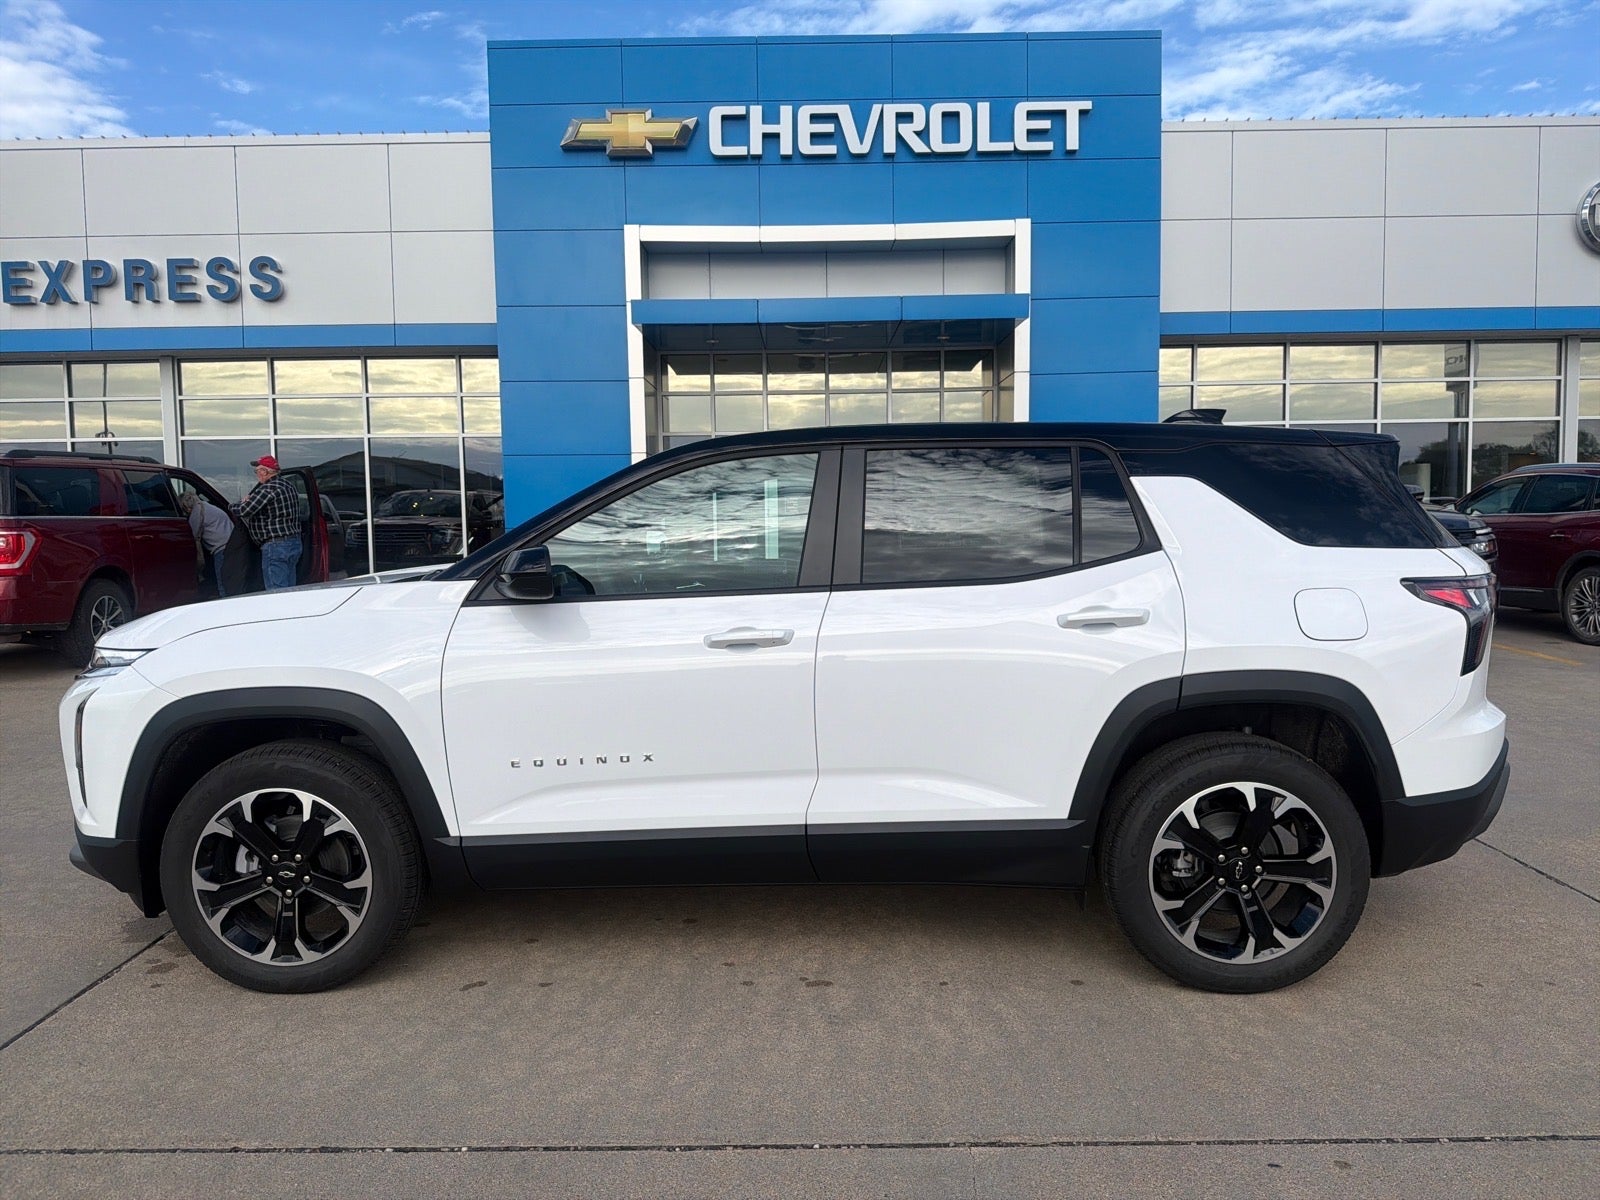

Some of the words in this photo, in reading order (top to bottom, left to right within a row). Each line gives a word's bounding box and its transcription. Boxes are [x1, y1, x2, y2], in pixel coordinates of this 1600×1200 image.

[708, 101, 1093, 157] CHEVROLET
[1, 255, 285, 305] EXPRESS
[510, 752, 654, 768] EQUINOX
